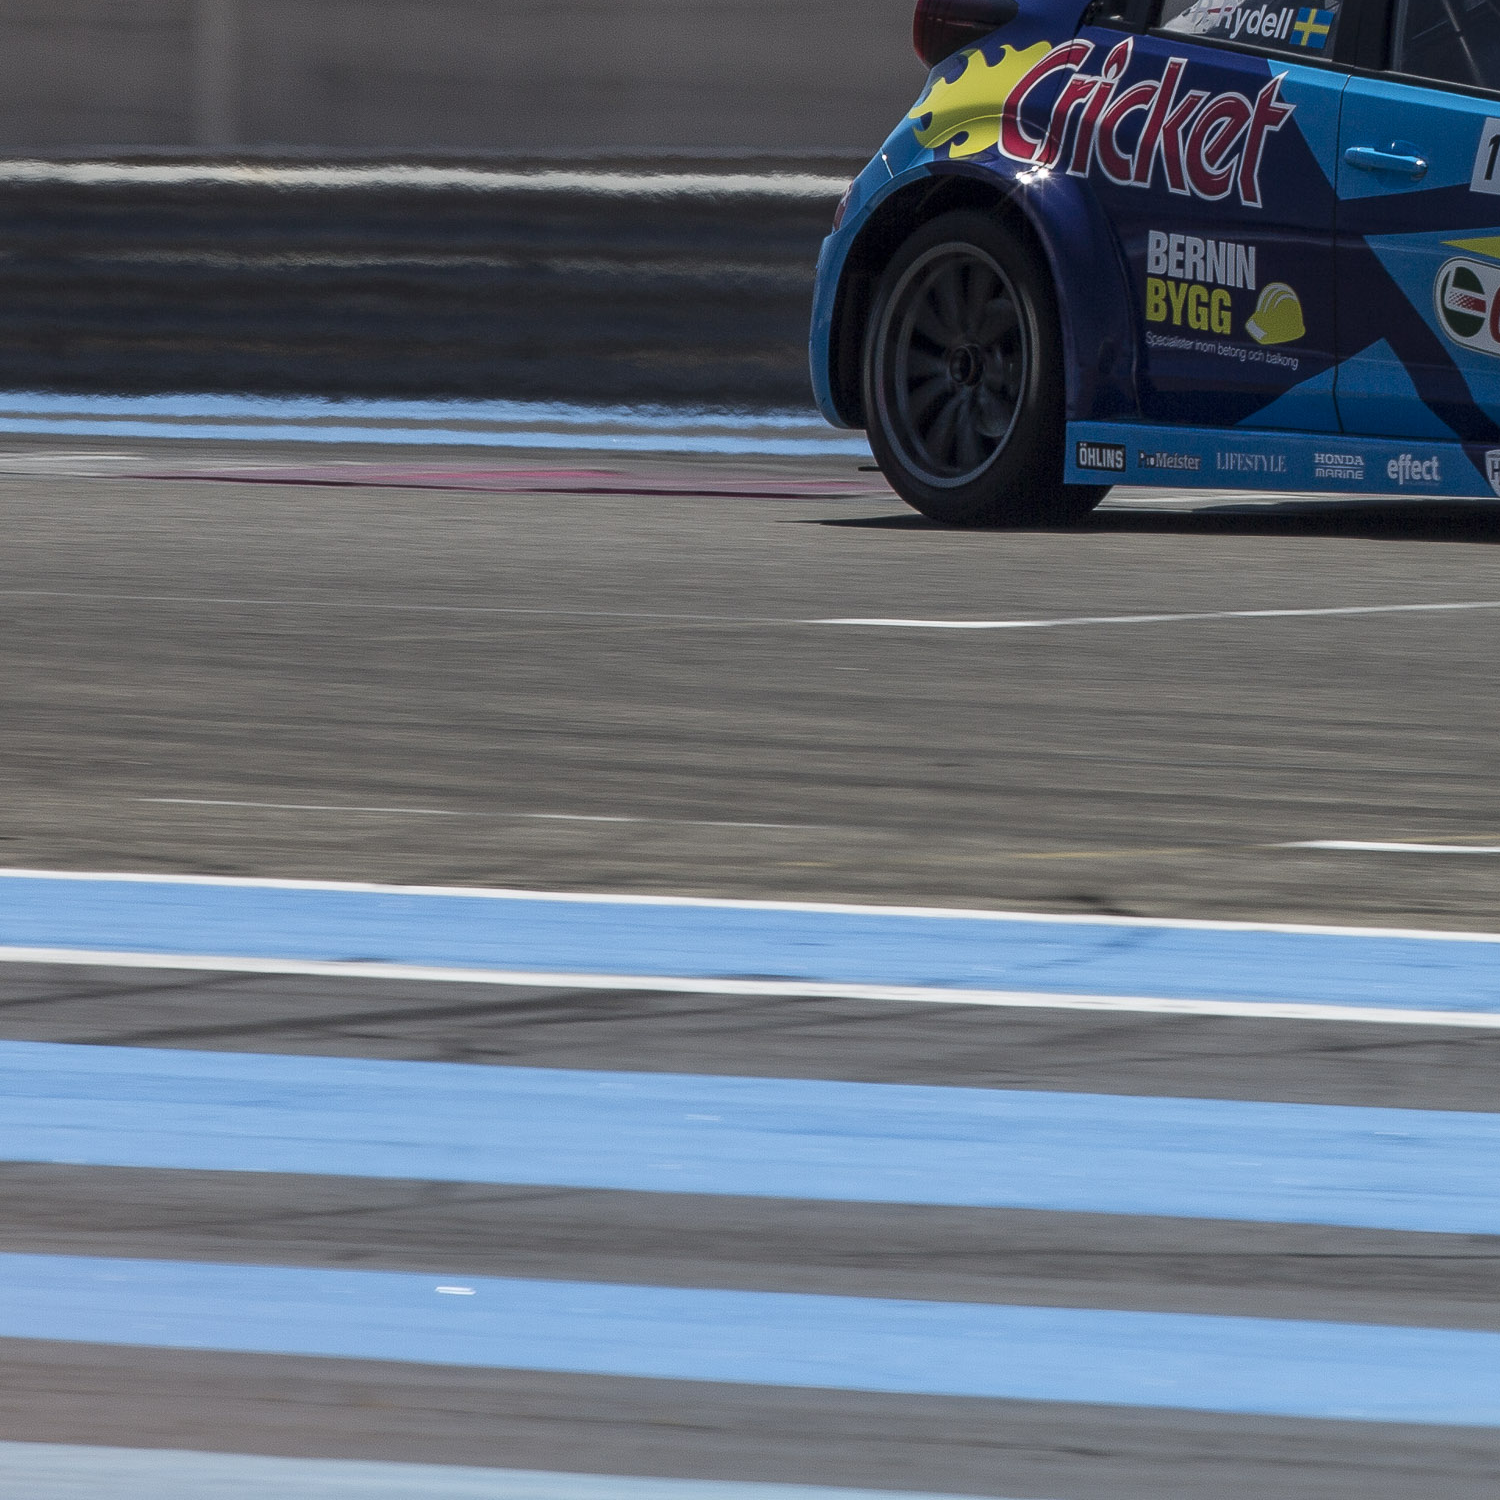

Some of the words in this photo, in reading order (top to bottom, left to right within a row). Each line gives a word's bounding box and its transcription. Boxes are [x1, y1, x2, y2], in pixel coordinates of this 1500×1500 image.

[997, 36, 1297, 209] Cricket
[1147, 229, 1257, 291] BERNIN
[1145, 277, 1232, 335] BYGG
[1145, 331, 1194, 350] Specialister
[1195, 338, 1216, 353] inom
[1217, 343, 1246, 362] betong
[1249, 349, 1265, 362] och
[1265, 350, 1299, 371] balkong
[1079, 442, 1124, 469] ÖHLINS
[1216, 452, 1287, 473] LIFESTYLE
[1314, 453, 1365, 466] HONDA
[1387, 453, 1442, 485] effect
[1315, 468, 1365, 480] MARINE
